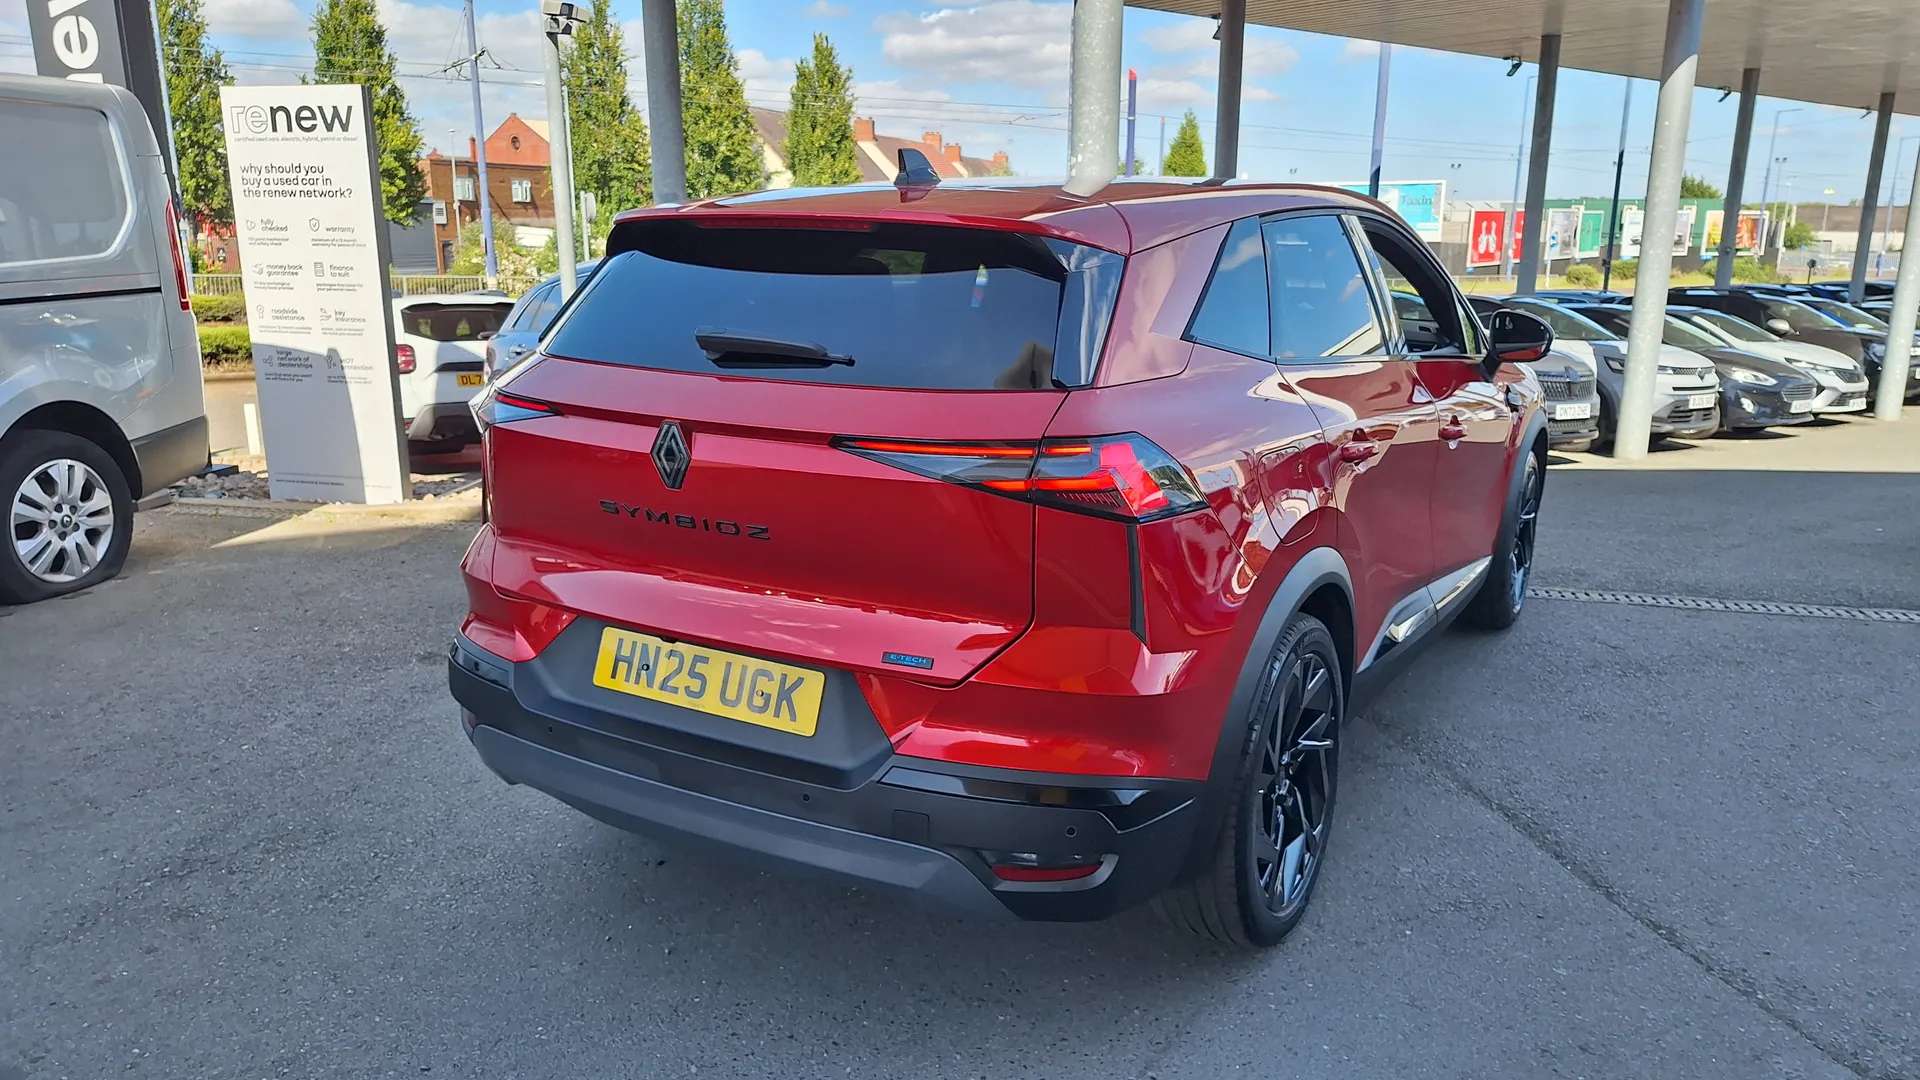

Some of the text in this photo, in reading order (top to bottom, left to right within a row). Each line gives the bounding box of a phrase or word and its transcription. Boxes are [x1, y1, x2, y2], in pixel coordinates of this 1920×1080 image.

[230, 105, 353, 135] renew
[240, 163, 324, 176] why should you
[242, 175, 332, 188] buy a used car in
[243, 187, 353, 198] the renew network?
[600, 499, 770, 540] SYMBIOZ
[610, 637, 805, 722] HN25 UGK
